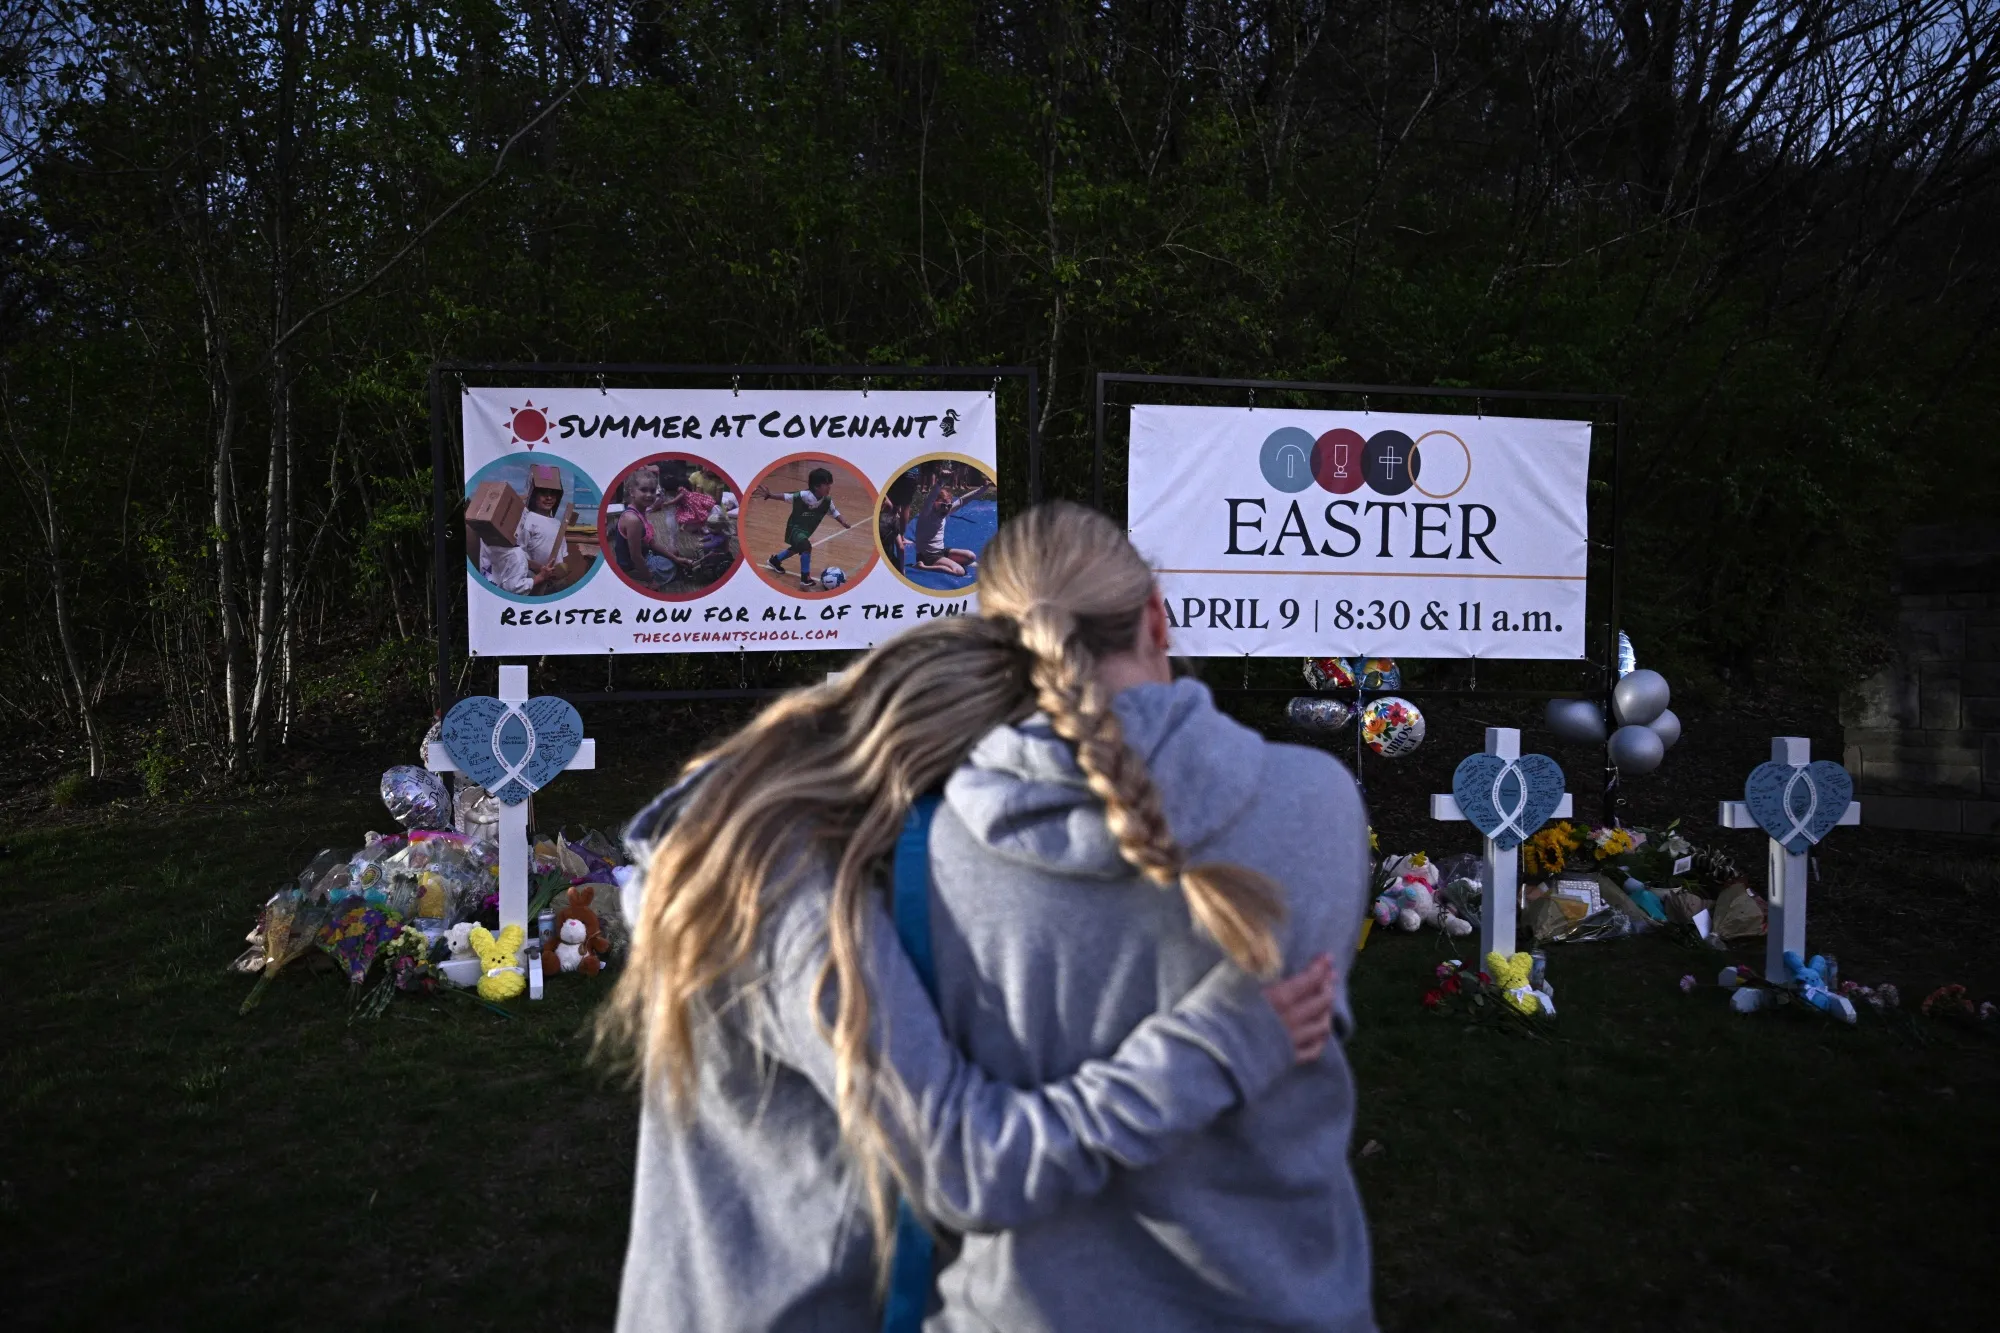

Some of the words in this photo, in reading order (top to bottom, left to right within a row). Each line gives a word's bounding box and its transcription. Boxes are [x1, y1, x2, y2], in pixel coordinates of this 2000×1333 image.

[559, 415, 702, 439] SUMMER
[710, 414, 757, 438] AT
[759, 411, 937, 439] COVENANT
[1224, 498, 1502, 565] EASTER
[501, 606, 622, 626] REGISTER
[636, 606, 692, 623] NOW
[704, 606, 750, 622] FOR
[762, 606, 806, 622] ALL
[821, 605, 851, 620] OF
[862, 603, 905, 619] THE
[916, 600, 967, 618] FUN!
[1163, 597, 1269, 631] APRIL
[1280, 599, 1299, 629] 9
[1334, 600, 1410, 630] 8:30
[1421, 601, 1448, 630] &
[1459, 602, 1481, 630] 11
[1492, 611, 1562, 632] a.m.
[633, 630, 838, 643] THECOVENANTSCHOOL.COM
[1384, 725, 1413, 756] SORRY
